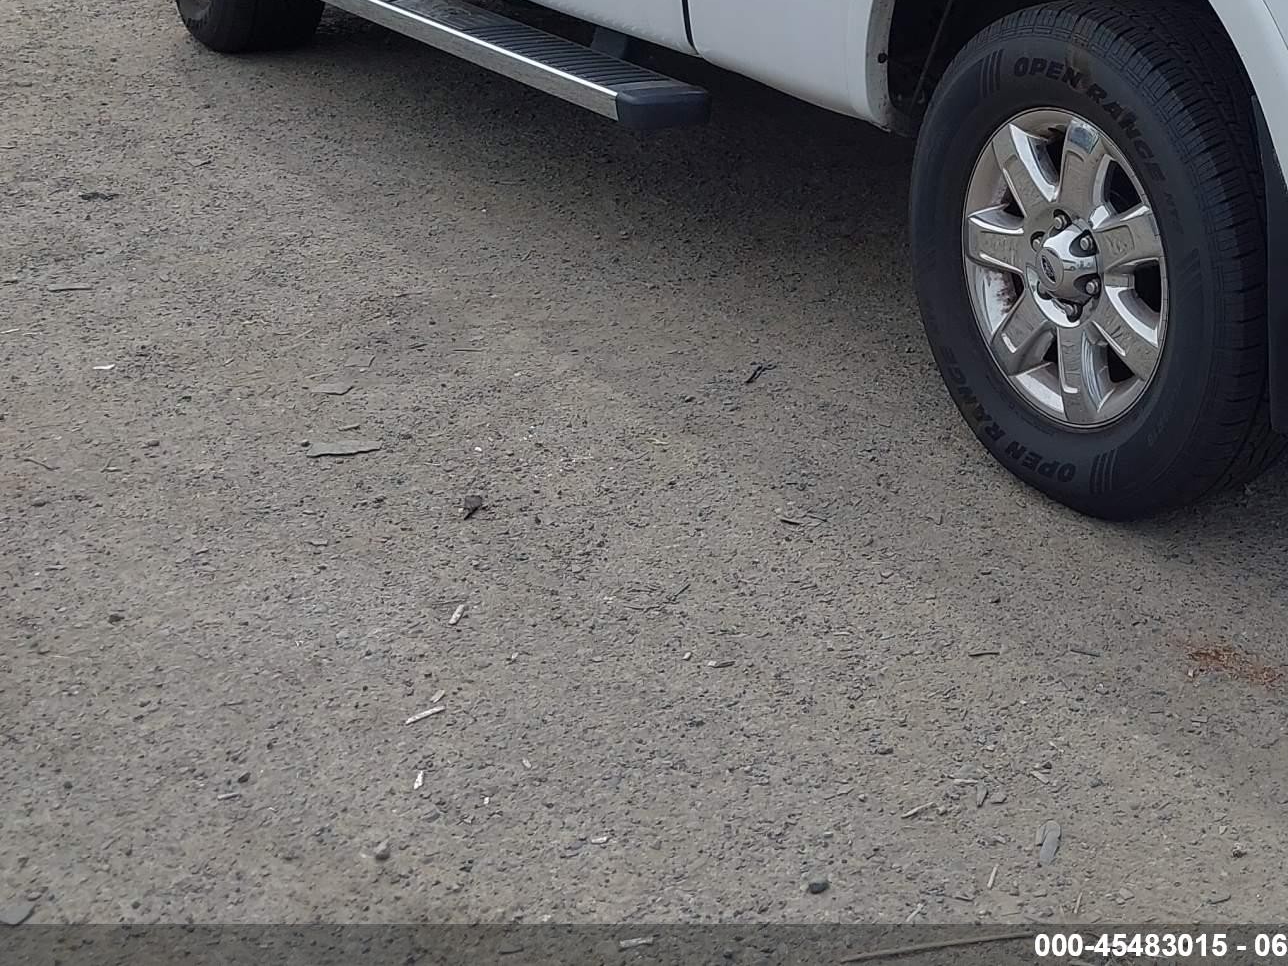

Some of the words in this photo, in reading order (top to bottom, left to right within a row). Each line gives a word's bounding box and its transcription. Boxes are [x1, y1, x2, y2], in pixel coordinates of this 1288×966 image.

[1013, 56, 1083, 90] OPEN
[1085, 82, 1167, 183] RANGE
[1004, 440, 1077, 483] OPEN
